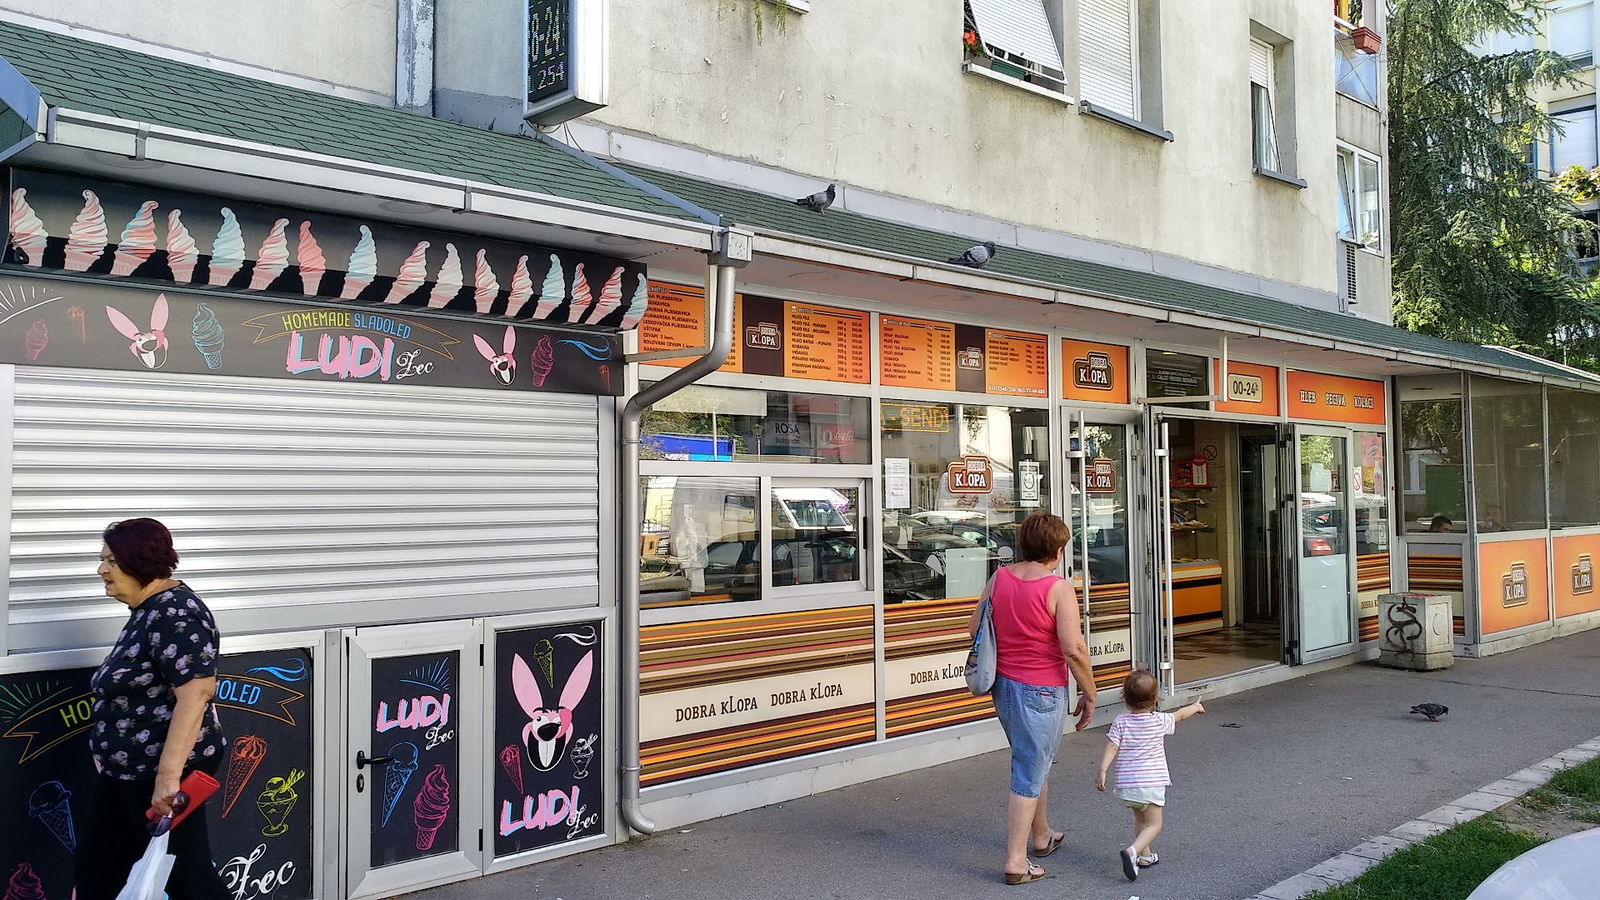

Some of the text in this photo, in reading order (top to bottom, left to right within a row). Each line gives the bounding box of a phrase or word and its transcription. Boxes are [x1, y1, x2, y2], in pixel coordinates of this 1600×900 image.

[282, 312, 351, 331] HOMEMADE
[354, 313, 411, 339] SLADOLED
[751, 333, 776, 346] KLOPA
[286, 331, 395, 381] LUDI
[396, 349, 434, 379] Zec
[1091, 357, 1107, 368] DOBRA
[1080, 366, 1107, 384] KLOPA
[1300, 390, 1316, 404] HLEB
[1325, 392, 1346, 406] PECIVA
[775, 423, 800, 434] ROSA
[955, 470, 986, 487] KLOPA
[1087, 472, 1111, 487] KLOPA
[1090, 641, 1124, 656] BRA KLOPA
[910, 669, 940, 684] DOBRA
[216, 680, 261, 705] OLED
[675, 682, 843, 722] DOBRA KLOPA DOBRA KLOPA
[376, 693, 451, 734] LUDI
[425, 723, 454, 751] Zec
[499, 785, 581, 836] LUDI
[566, 804, 598, 839] Zec
